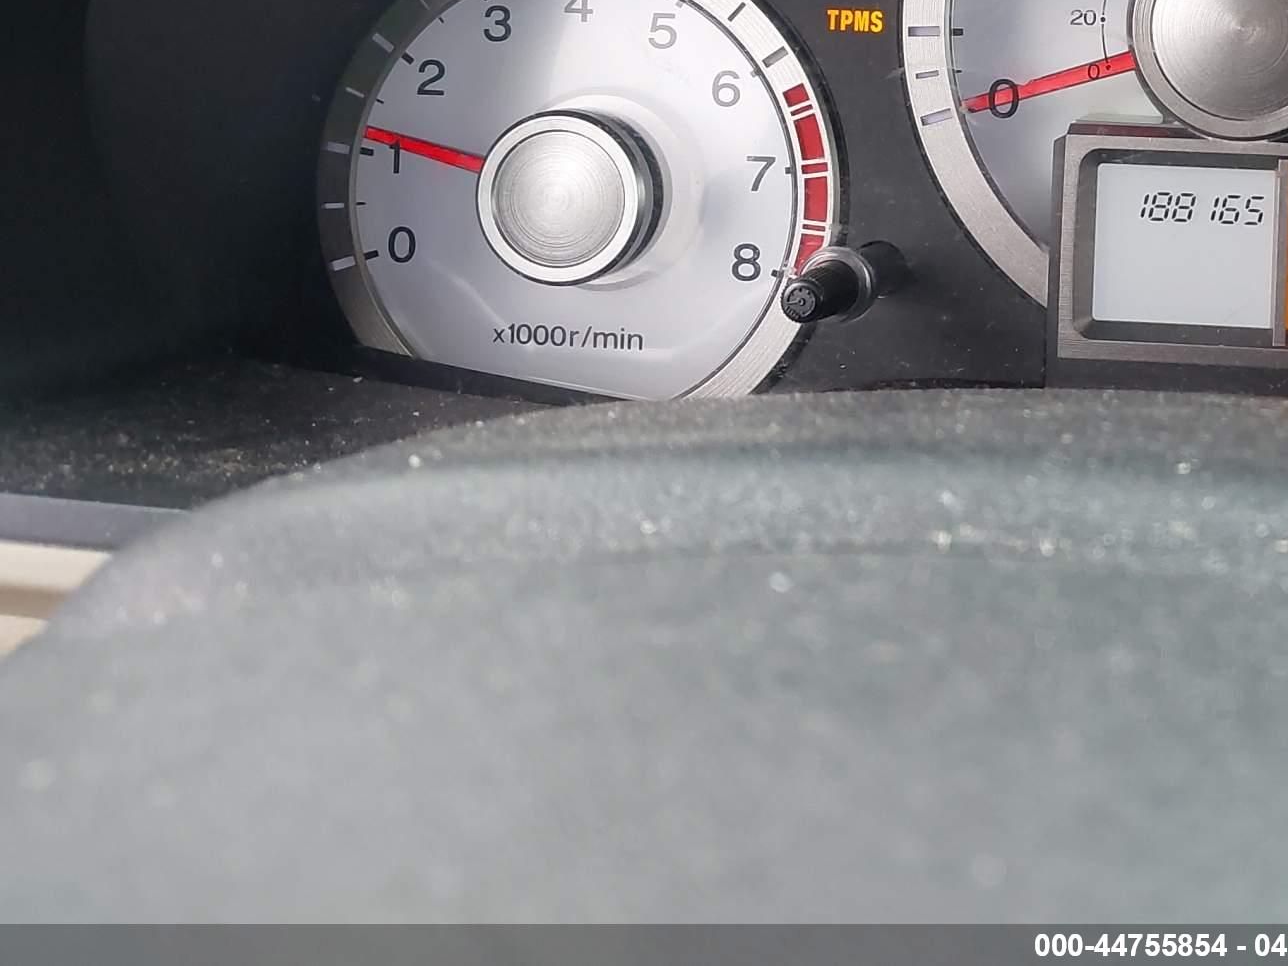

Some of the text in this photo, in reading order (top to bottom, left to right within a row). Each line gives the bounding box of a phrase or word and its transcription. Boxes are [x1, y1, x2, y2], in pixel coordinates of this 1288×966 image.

[483, 6, 512, 42] 3
[648, 13, 677, 49] 5
[828, 9, 883, 33] TPMS
[1070, 11, 1096, 27] 20
[416, 59, 446, 96] 2
[711, 71, 741, 107] 6
[988, 79, 1019, 117] 0
[390, 140, 402, 173] 1
[745, 155, 776, 192] 7
[1140, 191, 1265, 226] 188165
[388, 226, 416, 263] 0
[731, 243, 761, 280] 8
